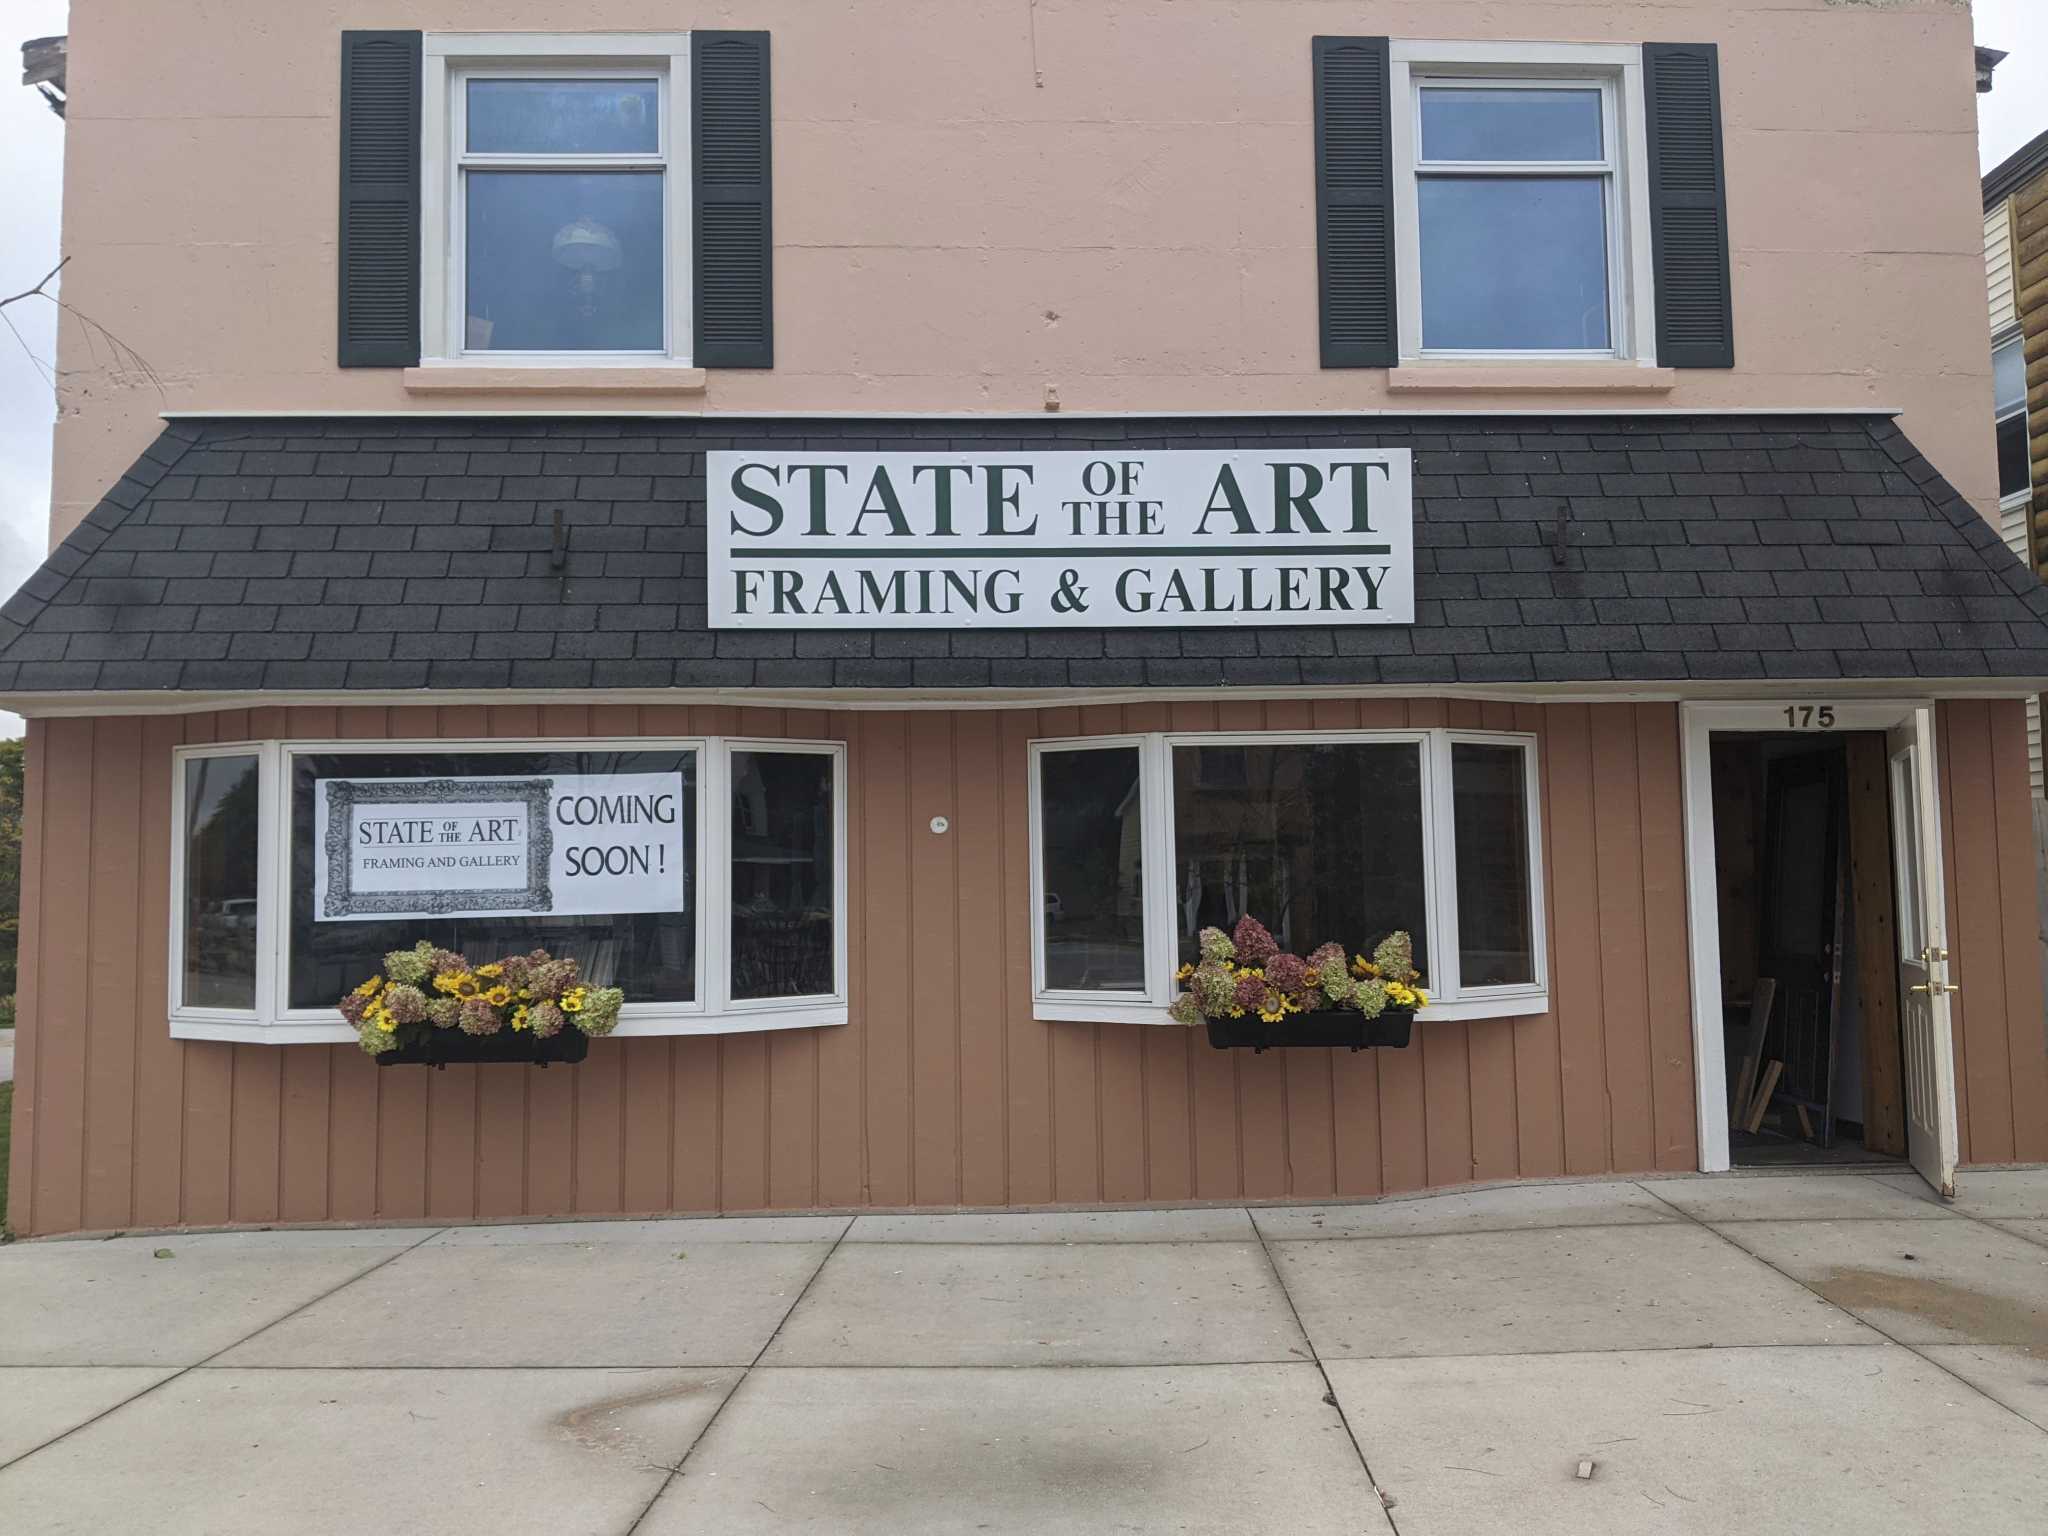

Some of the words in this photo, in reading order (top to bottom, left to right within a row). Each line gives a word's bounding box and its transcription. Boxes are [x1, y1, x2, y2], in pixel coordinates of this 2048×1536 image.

[1082, 460, 1145, 497] OF
[730, 463, 1039, 537] STATE
[1191, 462, 1391, 535] ART
[1061, 500, 1165, 536] THE
[731, 568, 1024, 615] FRAMING
[1050, 568, 1090, 614] &
[1115, 566, 1391, 613] GALLERY
[1783, 705, 1836, 728] 175
[556, 794, 675, 826] COMING
[359, 820, 434, 845] STATE
[438, 832, 462, 843] THE
[442, 821, 458, 832] OF
[467, 819, 518, 842] ART
[363, 857, 425, 869] FRAMING
[427, 856, 457, 868] AND
[459, 855, 520, 867] GALLERY
